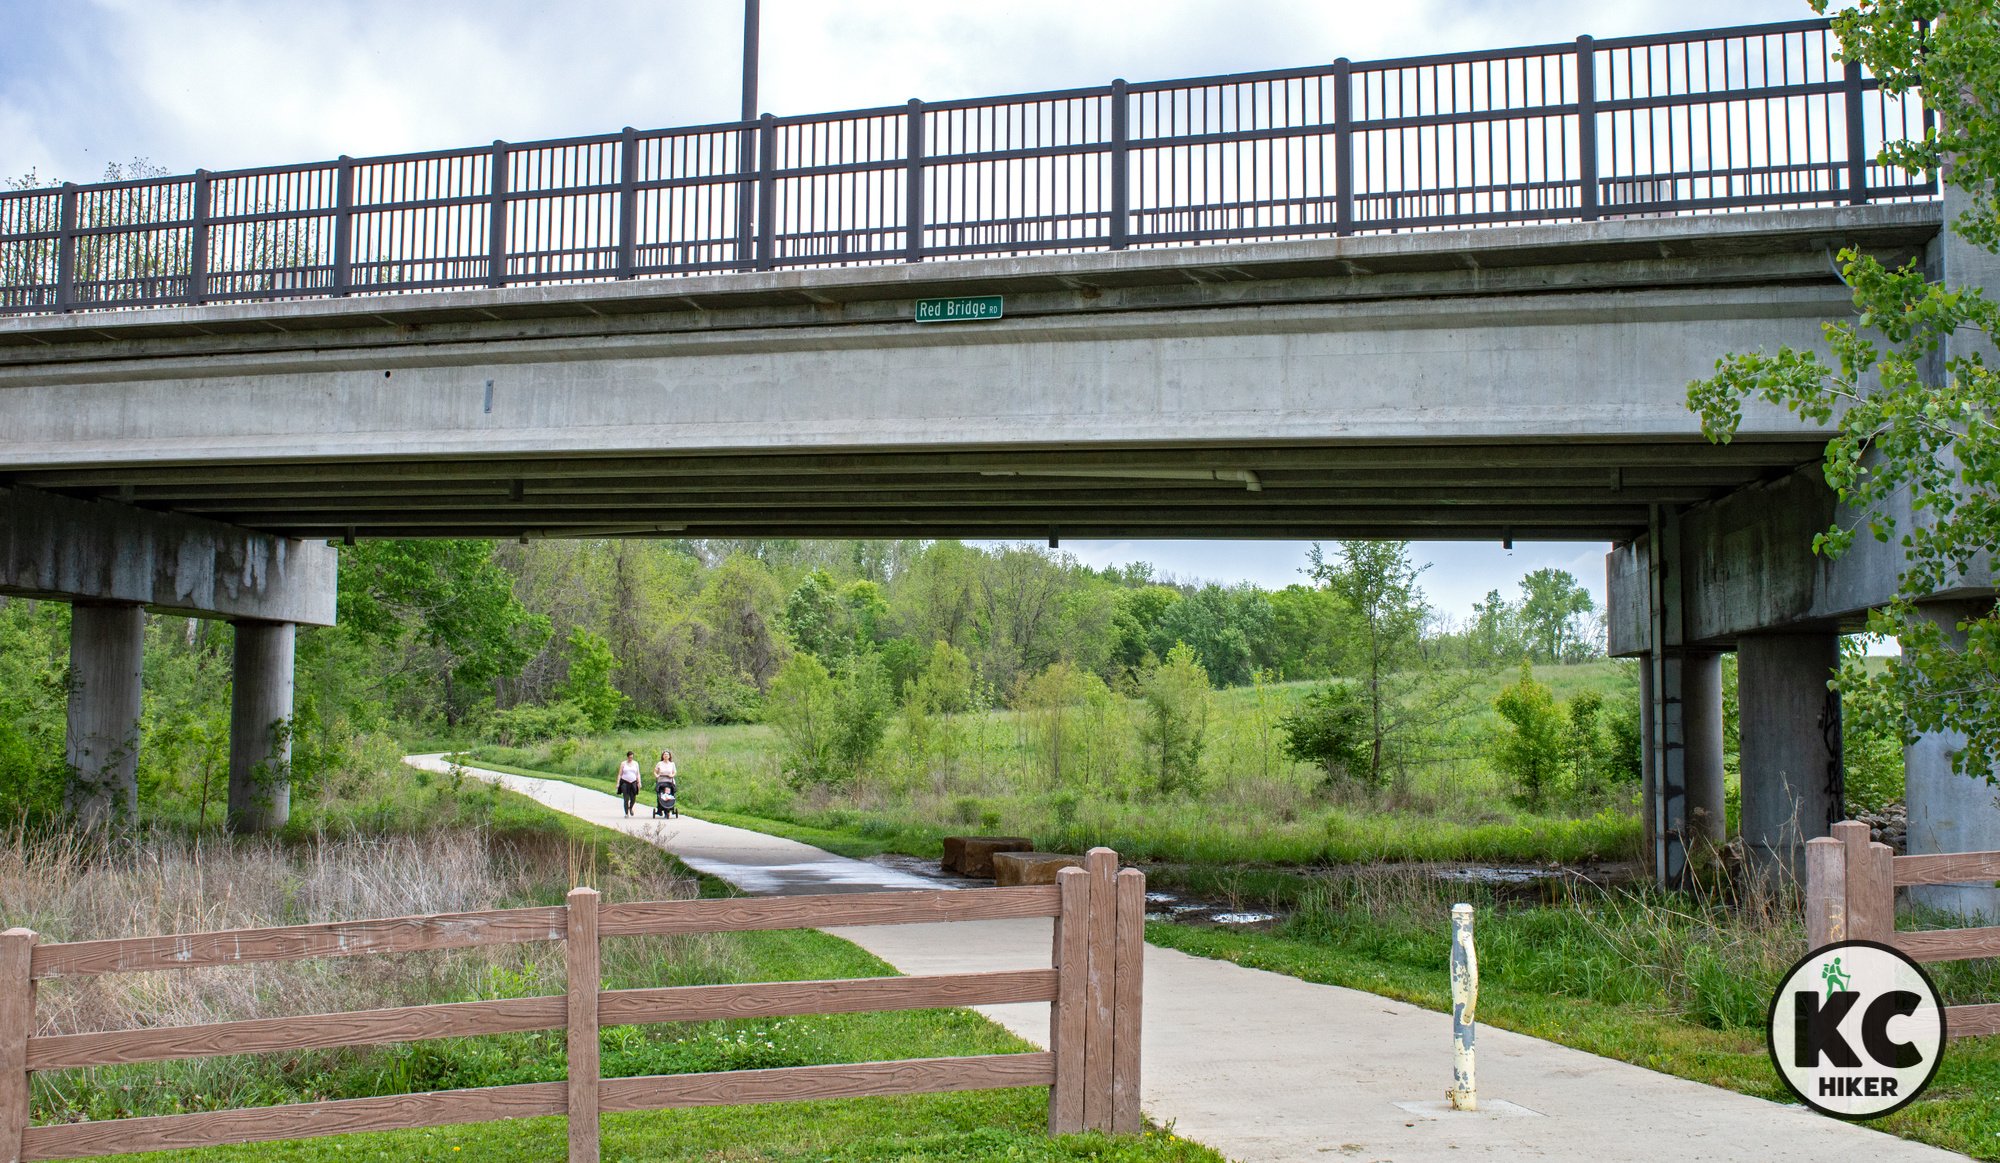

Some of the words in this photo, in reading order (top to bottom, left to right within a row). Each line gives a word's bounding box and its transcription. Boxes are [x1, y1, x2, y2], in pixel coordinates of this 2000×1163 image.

[920, 302, 941, 317] Red
[947, 300, 986, 318] Bridge
[989, 305, 998, 314] RD
